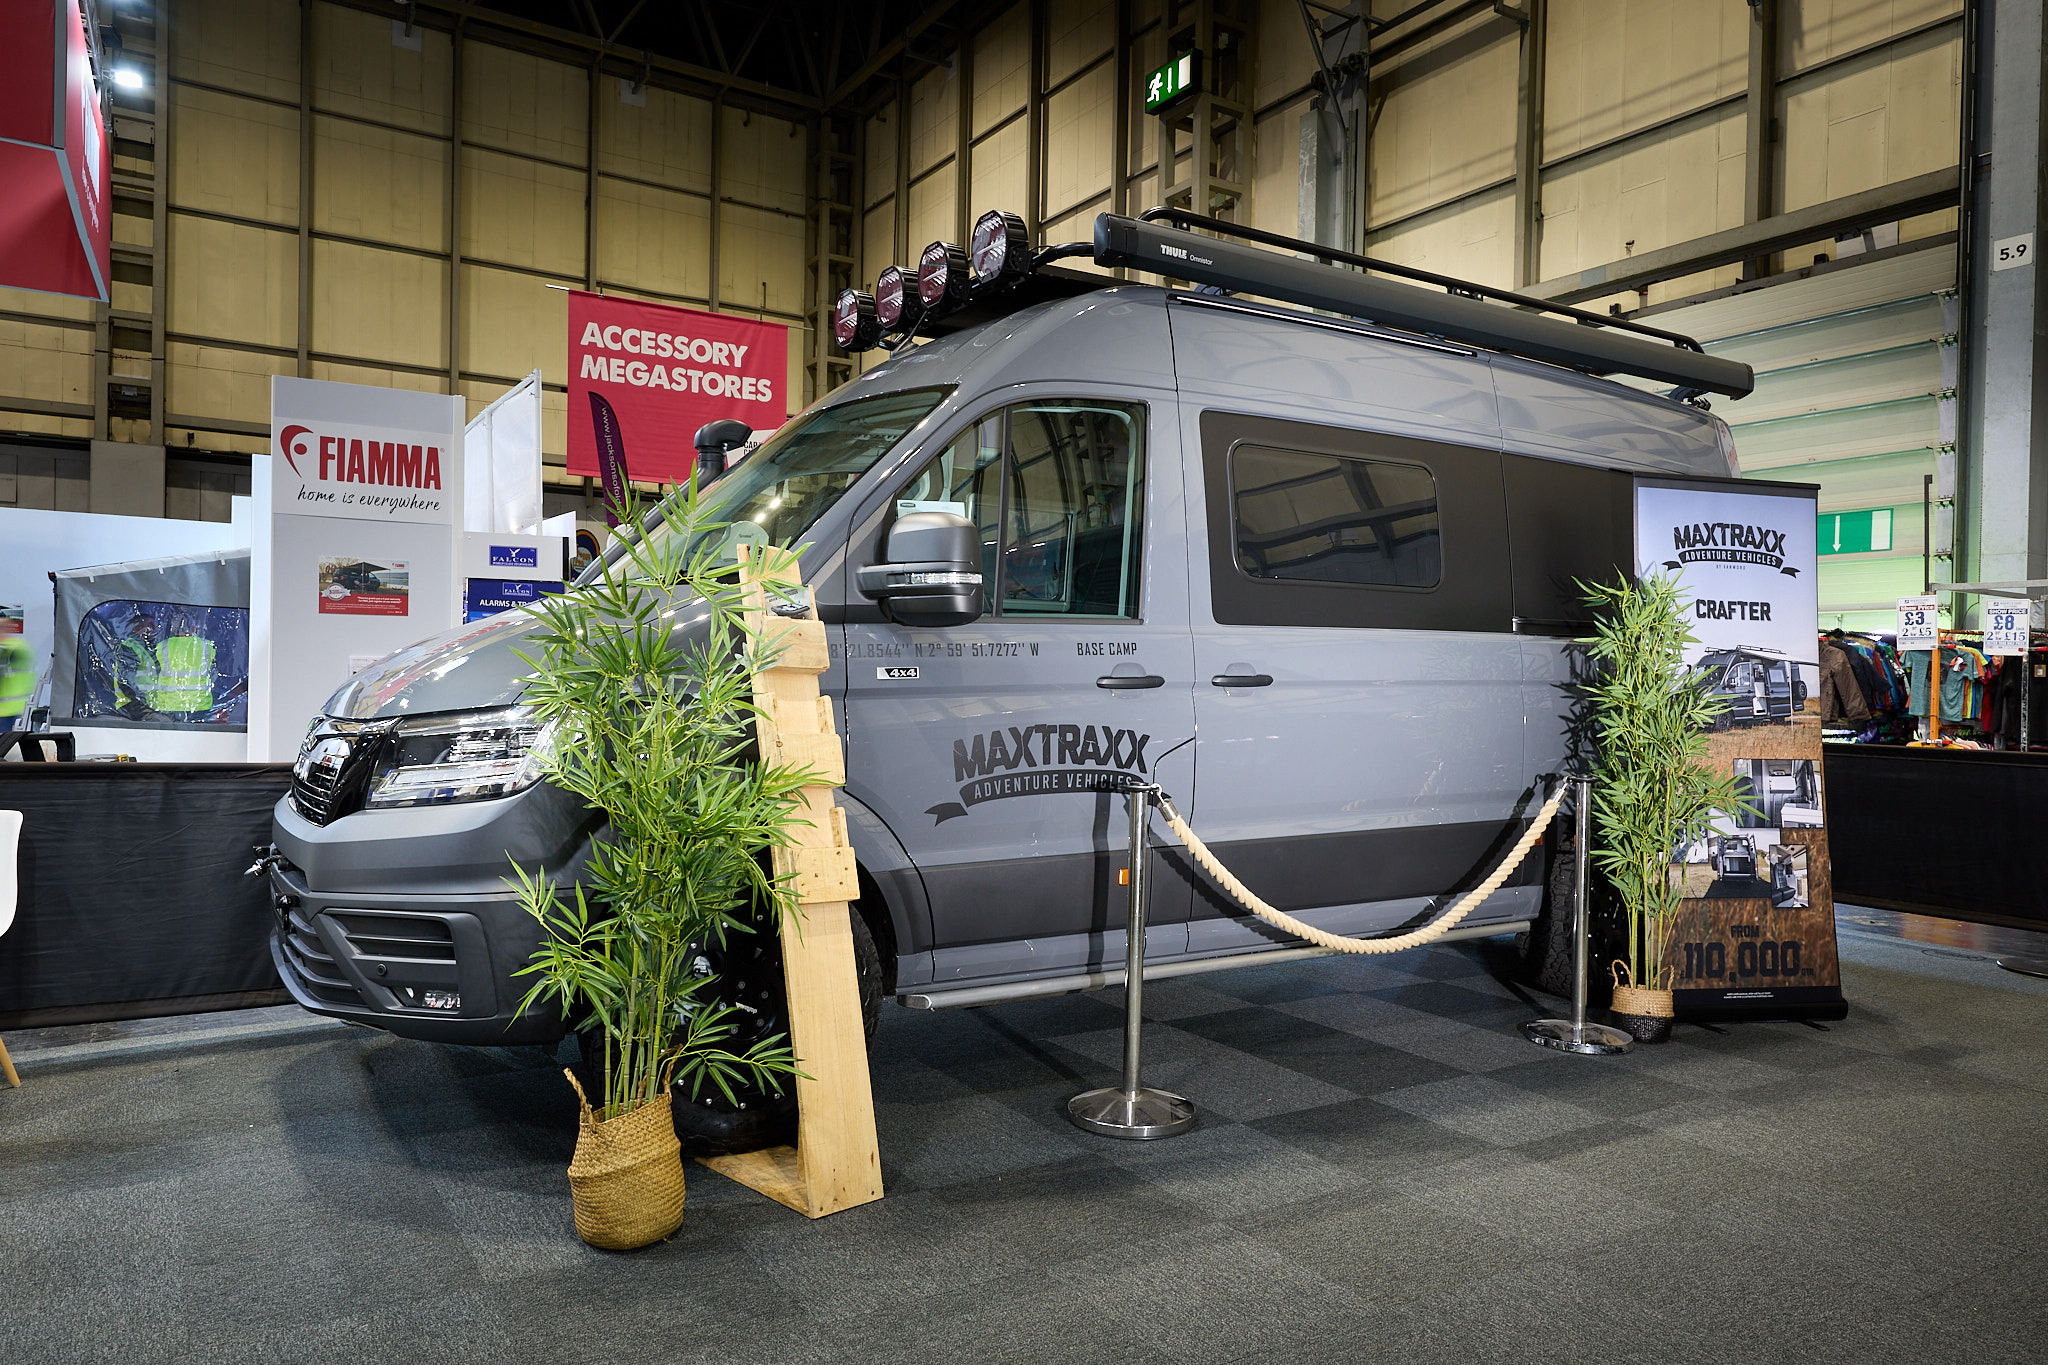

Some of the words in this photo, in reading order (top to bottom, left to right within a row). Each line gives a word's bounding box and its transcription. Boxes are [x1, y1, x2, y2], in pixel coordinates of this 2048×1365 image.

[1160, 244, 1187, 259] THULE
[1190, 255, 1213, 265] Omnistor
[2000, 244, 2027, 261] 5.9
[580, 322, 748, 367] ACCESSORY
[580, 354, 772, 402] MEGASTORES
[319, 436, 441, 490] FIAMMA
[297, 484, 336, 503] home
[342, 492, 355, 504] is
[359, 494, 440, 514] everywhere
[1674, 522, 1786, 557] MAXTRAXX
[1685, 551, 1732, 561] ADVENTURE
[1736, 551, 1777, 566] VEHICLES
[479, 599, 510, 607] ALARMS
[1695, 599, 1771, 621] CRAFTER
[1905, 611, 1925, 625] £3
[1994, 614, 2014, 630] £8
[1902, 628, 1909, 637] 2
[1919, 627, 1932, 637] £5
[1987, 632, 1993, 640] 2
[2005, 632, 2025, 640] £15
[915, 643, 923, 657] N
[1030, 643, 1039, 656] W
[1077, 642, 1105, 656] BASE
[1109, 642, 1137, 656] CAMP
[890, 669, 917, 677] 4x4
[953, 724, 1150, 782] MAXTRAXX
[974, 774, 1059, 799] ADVENTURE
[1731, 926, 1760, 938] FROM
